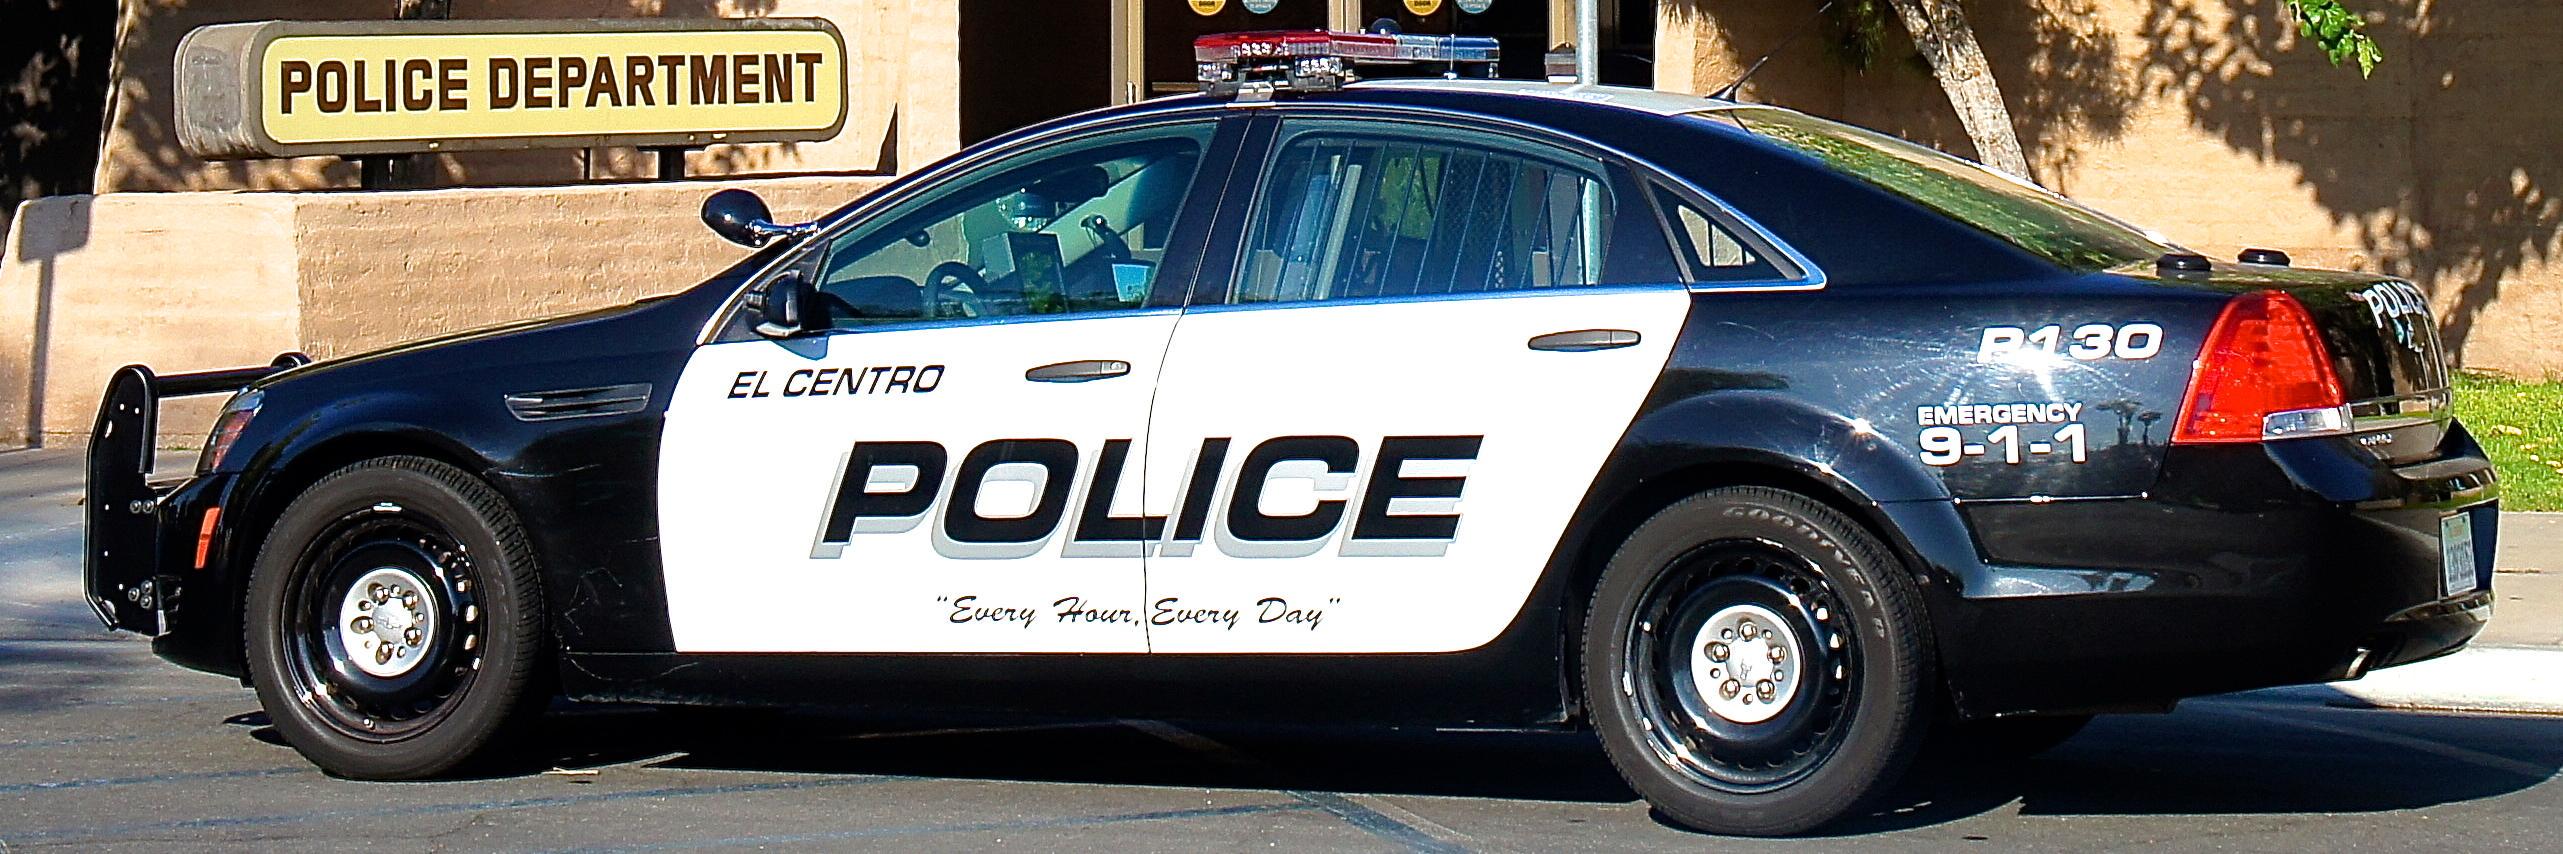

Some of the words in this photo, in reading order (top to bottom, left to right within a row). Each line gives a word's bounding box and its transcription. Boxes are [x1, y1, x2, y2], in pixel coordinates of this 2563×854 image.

[279, 58, 469, 115] POLICE
[489, 52, 824, 110] DEPARTMENT
[727, 370, 770, 399] EL
[783, 364, 945, 397] CENTRO
[1917, 402, 2083, 426] EMERGENCY
[1919, 422, 2087, 467] 9-1-1
[810, 434, 1485, 559] POLICE
[935, 594, 1038, 629] "Every
[1052, 595, 1141, 628] Hour,
[1151, 596, 1241, 631] Every
[1256, 596, 1341, 631] Day"
